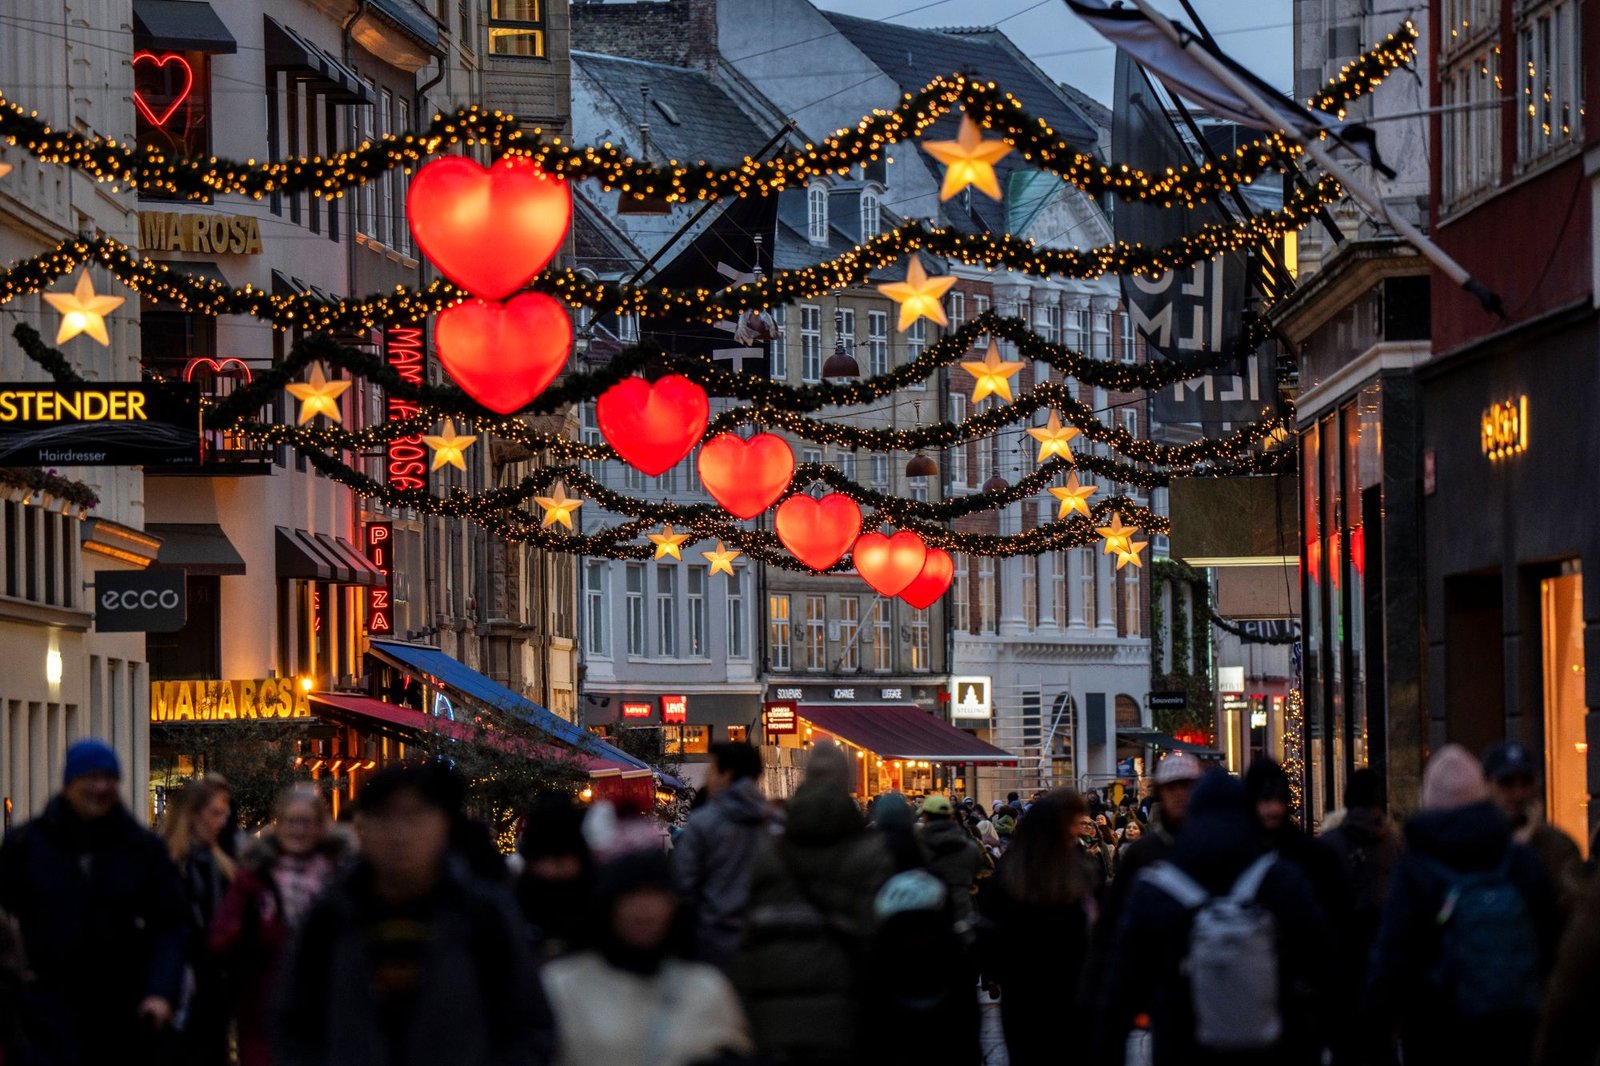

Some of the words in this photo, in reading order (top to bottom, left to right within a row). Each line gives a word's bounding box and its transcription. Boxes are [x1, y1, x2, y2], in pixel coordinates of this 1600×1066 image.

[138, 212, 187, 251] MA
[193, 214, 263, 254] ROSA
[0, 391, 148, 421] STENDER
[39, 449, 107, 461] Hairdresser
[371, 526, 388, 630] PIZA
[102, 589, 178, 610] ecco
[832, 688, 855, 699] XCHANGE
